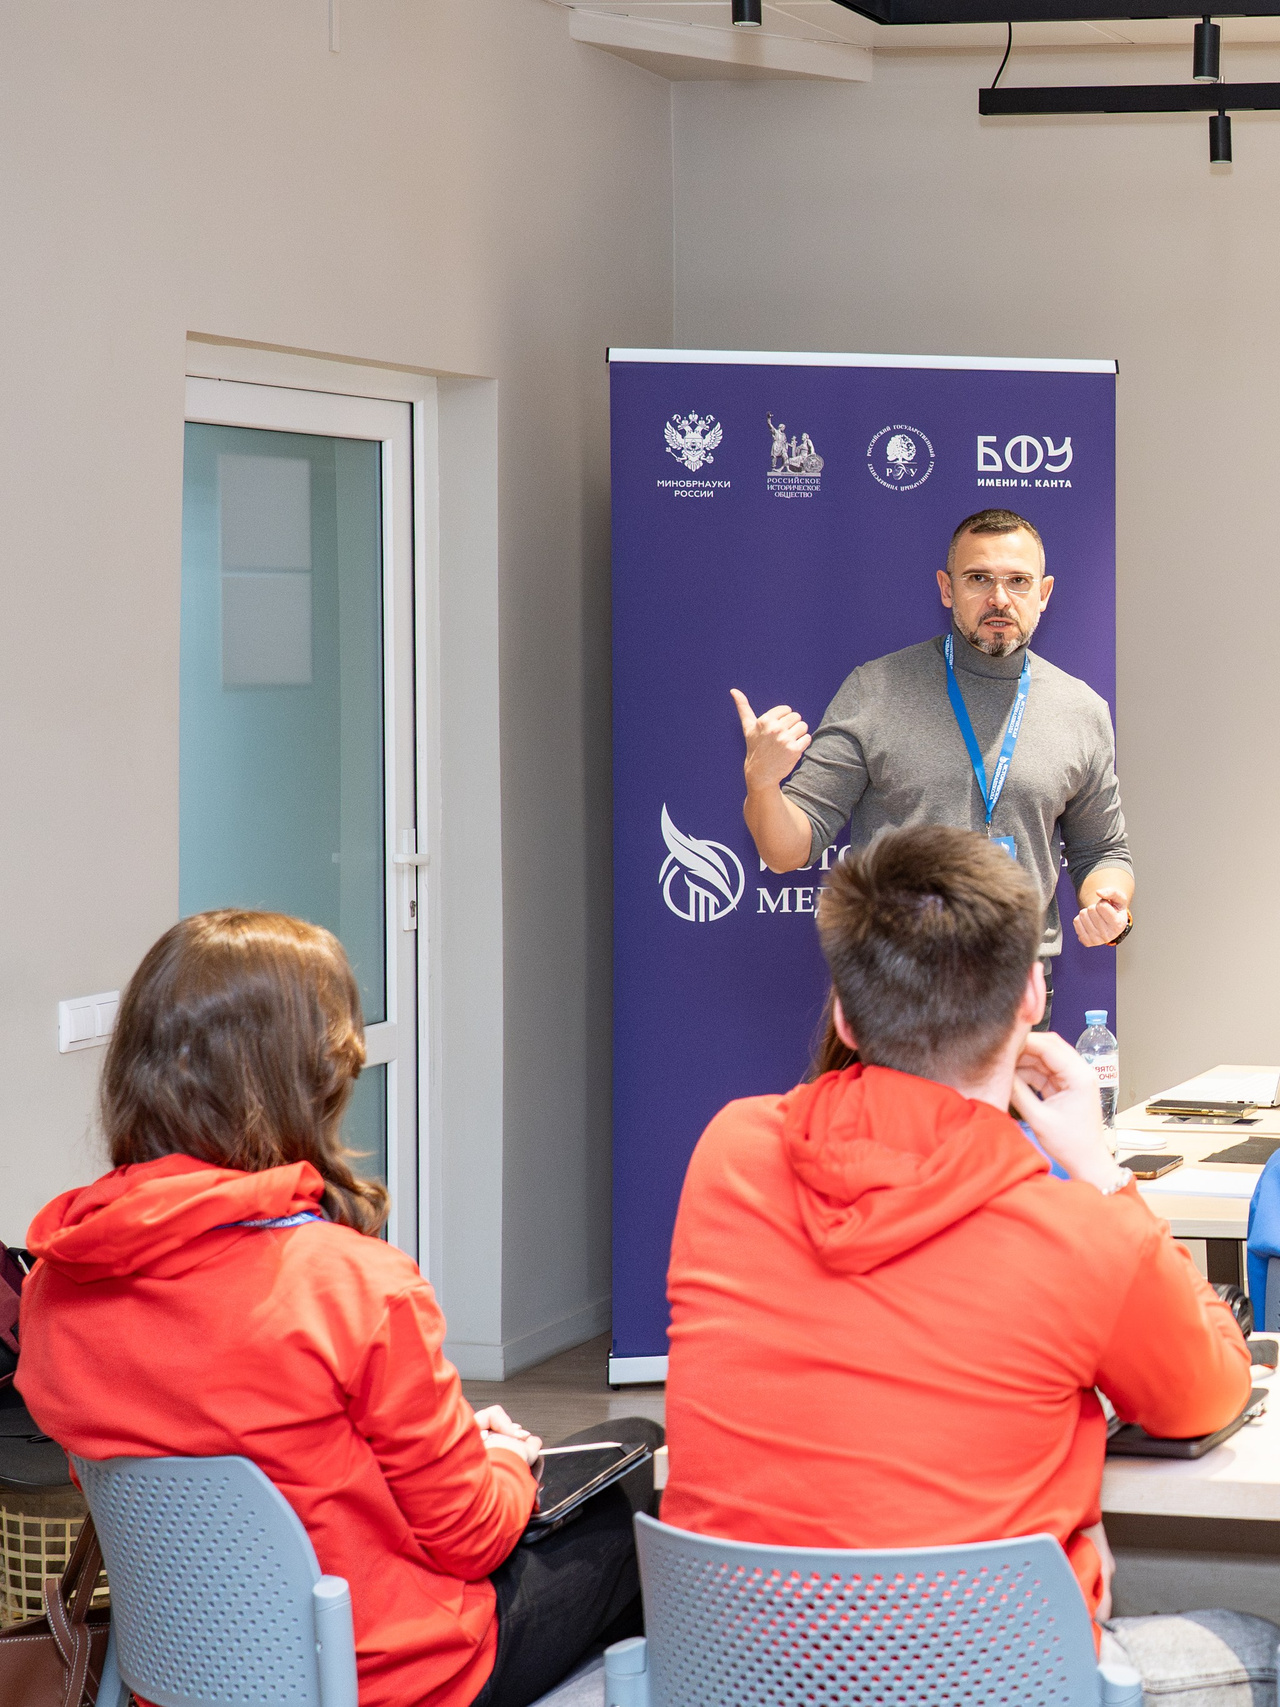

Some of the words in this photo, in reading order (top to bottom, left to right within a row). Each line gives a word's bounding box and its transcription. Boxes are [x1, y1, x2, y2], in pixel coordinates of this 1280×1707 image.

[977, 434, 1074, 474] БФУ
[656, 479, 731, 489] МИНОБРНАУКИ
[767, 477, 821, 485] РОССИЙСКОЕ
[977, 478, 1018, 488] ИМЕНИ
[1020, 478, 1032, 488] И.
[1034, 479, 1073, 488] КАНТА
[674, 489, 714, 498] РОССИИ
[774, 491, 813, 499] ОБЩЕСТВО
